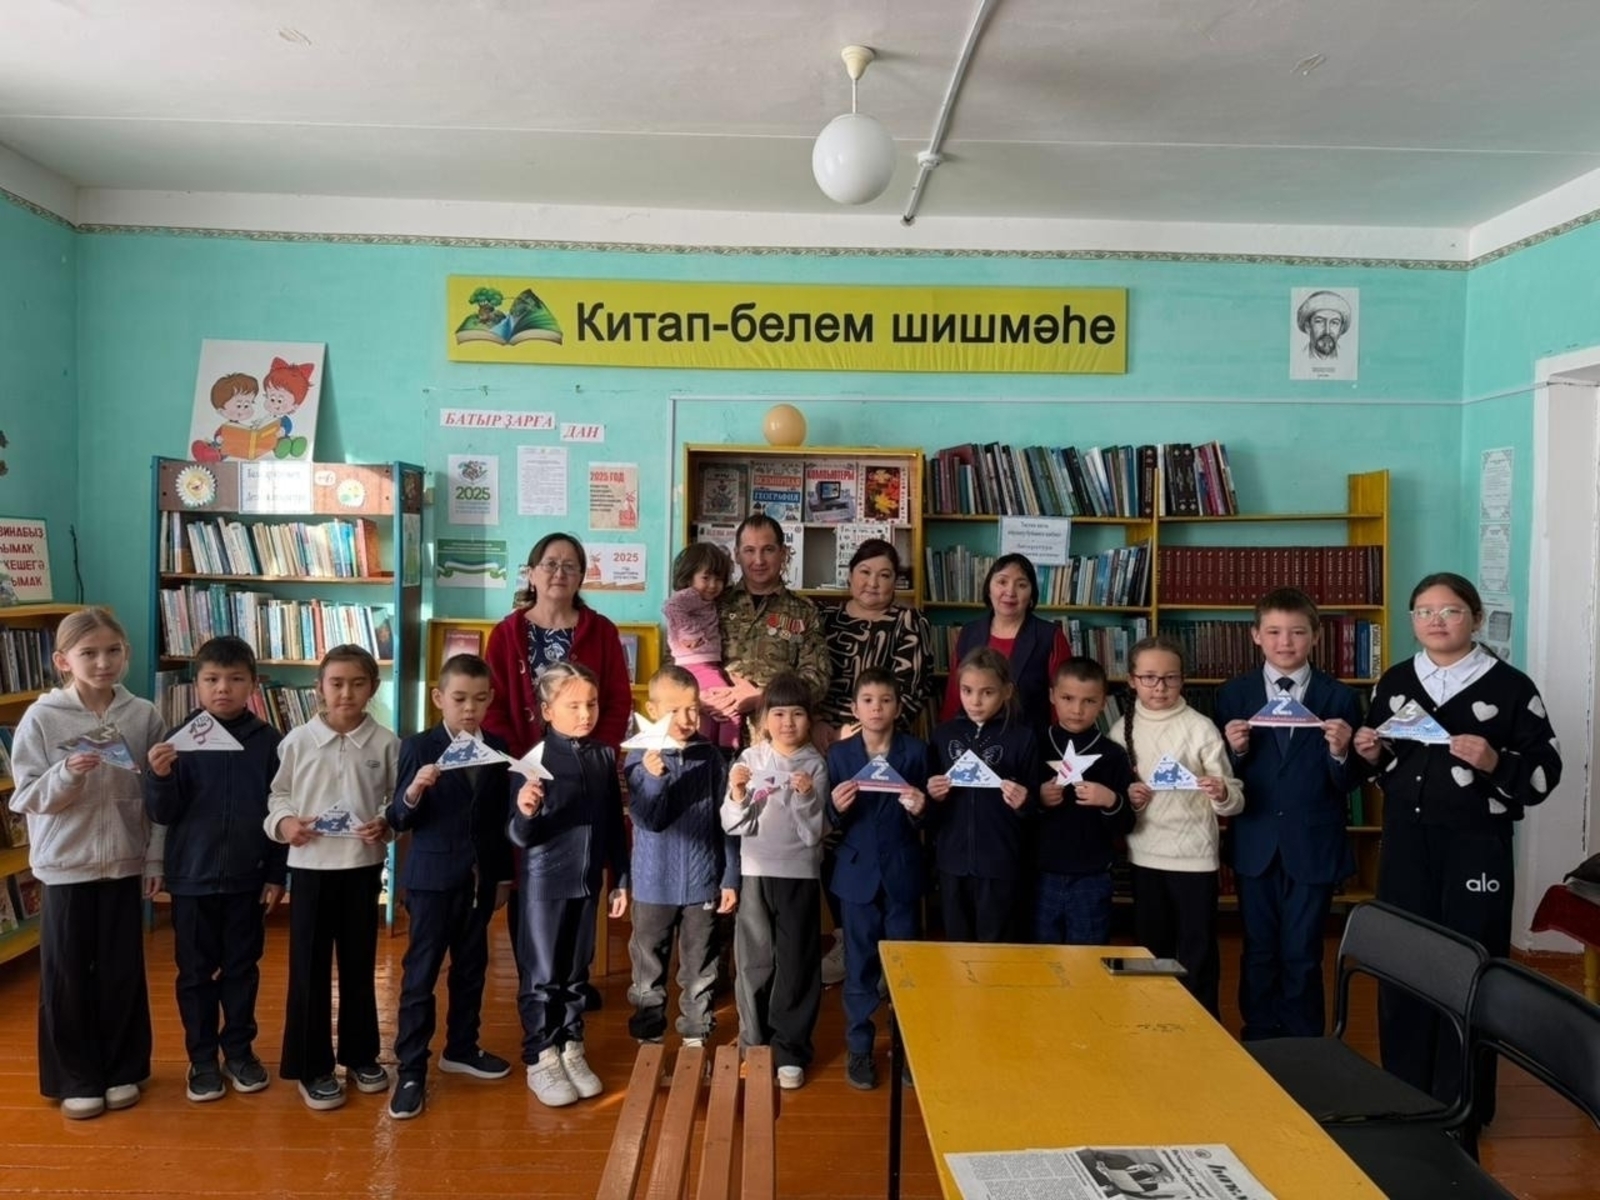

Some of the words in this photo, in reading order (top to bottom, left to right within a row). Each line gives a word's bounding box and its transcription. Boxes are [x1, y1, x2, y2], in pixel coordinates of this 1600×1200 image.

[577, 302, 874, 342] Китап-белем
[892, 304, 1116, 345] шишмәһе
[563, 425, 599, 439] ДАН
[590, 471, 608, 481] 2025
[807, 469, 855, 481] КОМПЬЮТЕРЫ
[455, 486, 491, 501] 2025
[754, 490, 800, 501] ГЕОГРАФИЯ
[613, 552, 639, 562] 2025
[870, 761, 890, 781] Z
[1466, 872, 1500, 892] alo
